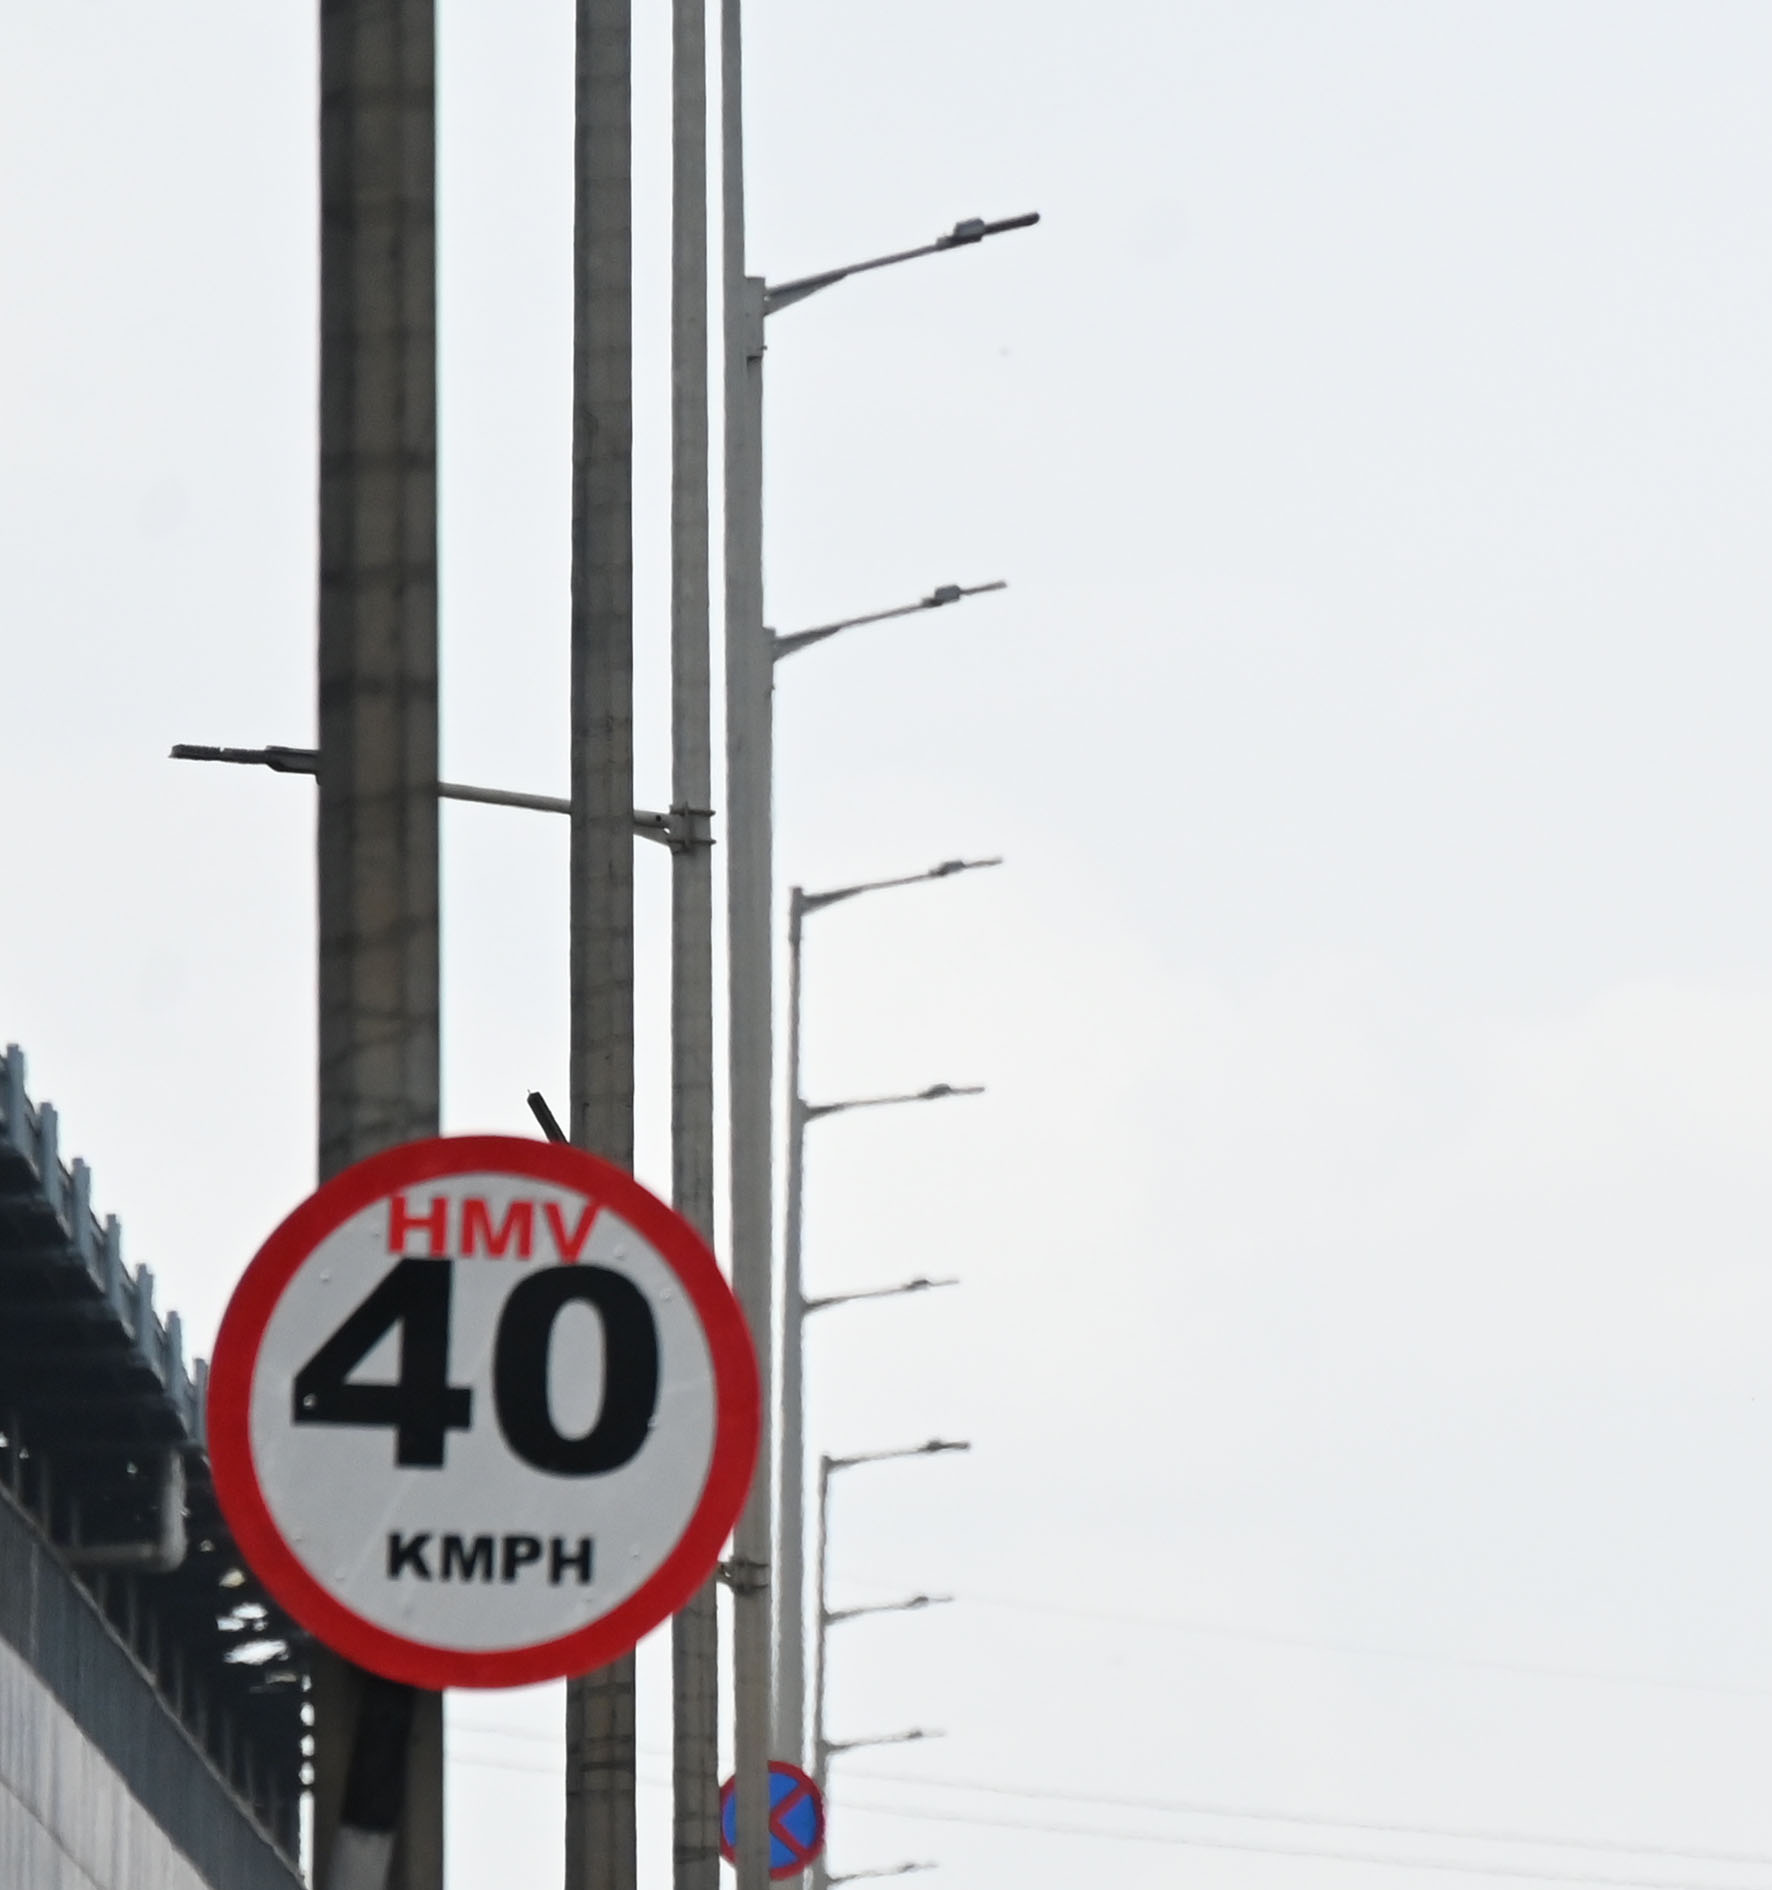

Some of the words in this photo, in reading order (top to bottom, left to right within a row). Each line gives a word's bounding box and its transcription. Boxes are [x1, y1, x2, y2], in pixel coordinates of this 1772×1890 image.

[387, 1194, 605, 1263] HMV
[291, 1257, 661, 1479] 40
[386, 1531, 594, 1586] KMPH
